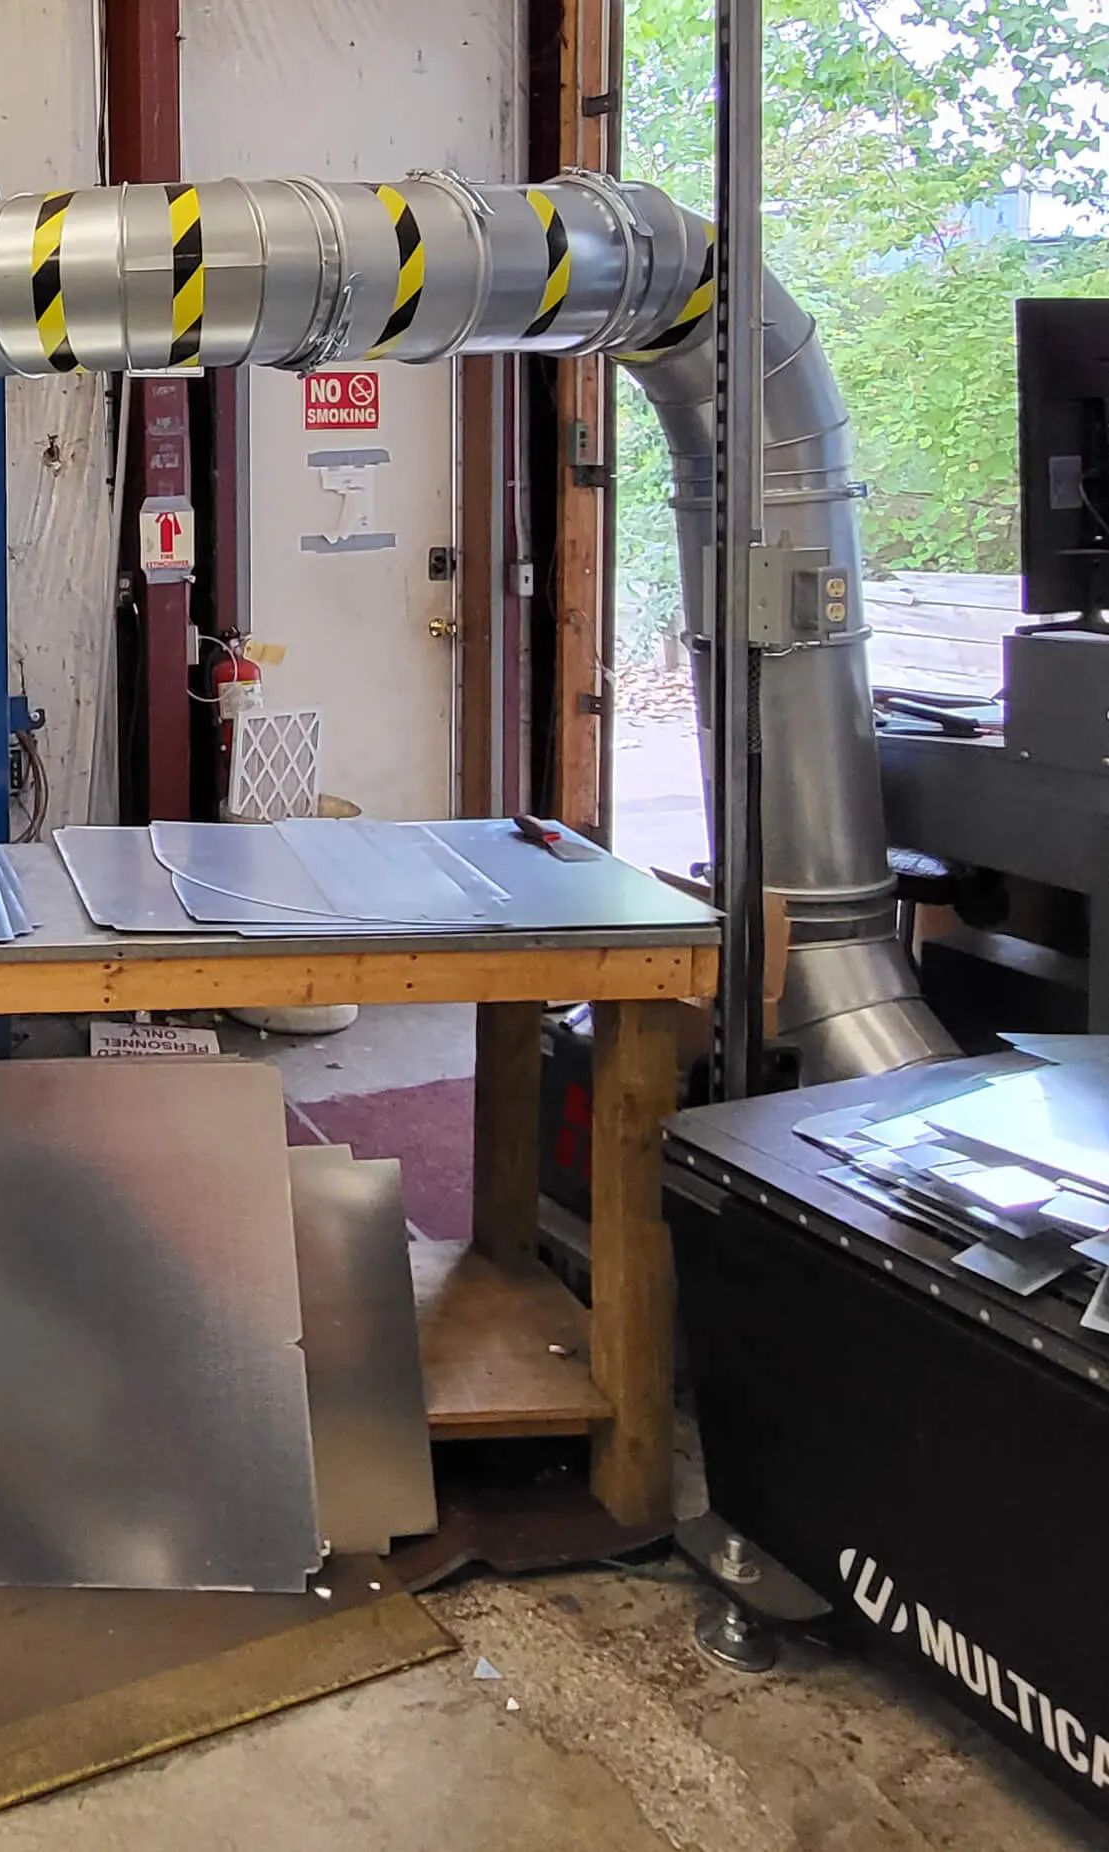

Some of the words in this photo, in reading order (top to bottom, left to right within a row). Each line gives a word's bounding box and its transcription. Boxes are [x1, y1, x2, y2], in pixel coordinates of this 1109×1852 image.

[310, 378, 341, 403] NO
[307, 407, 376, 423] SMOKING
[130, 1028, 177, 1039] ONLY
[100, 1038, 209, 1053] PERSONNEL
